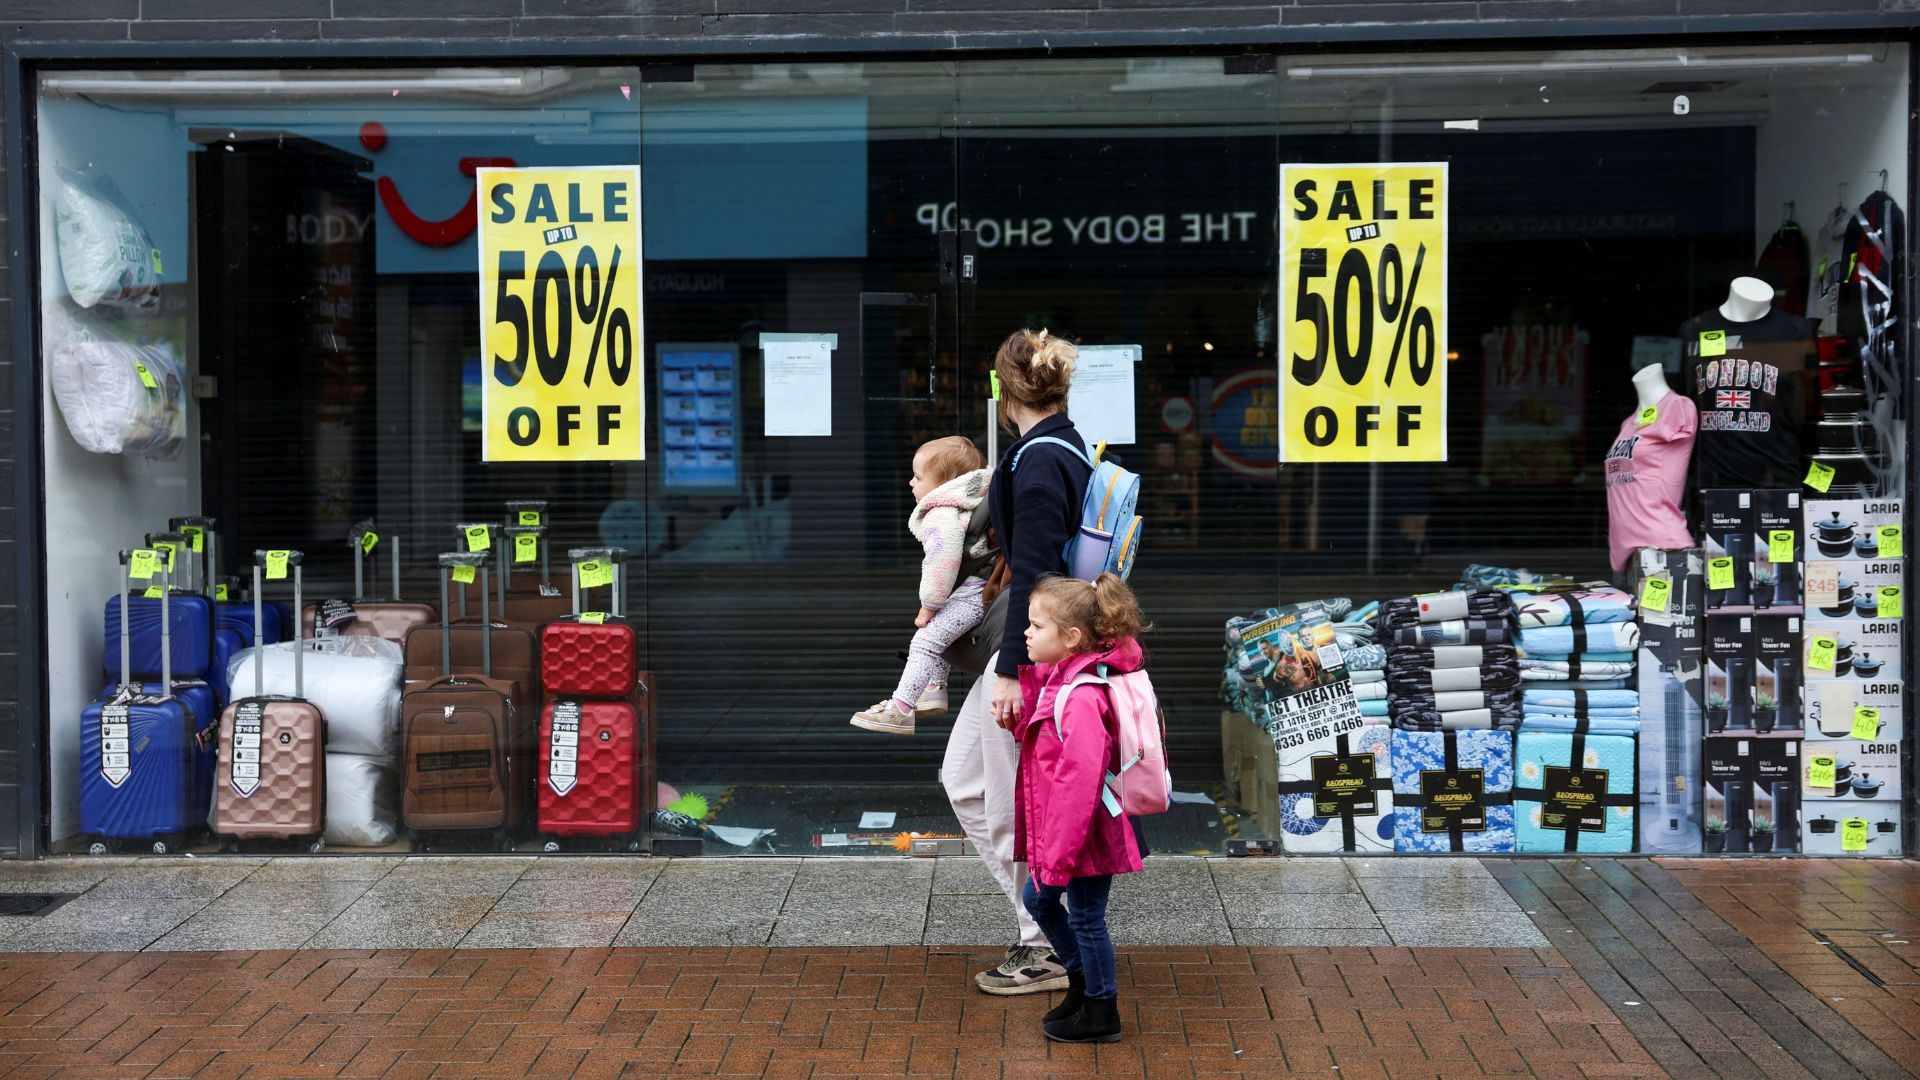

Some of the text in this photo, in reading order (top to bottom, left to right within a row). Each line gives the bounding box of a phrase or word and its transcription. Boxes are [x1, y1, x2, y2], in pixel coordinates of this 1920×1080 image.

[491, 182, 628, 223] SALE
[1293, 179, 1435, 221] SALE
[546, 226, 574, 244] UP TO
[1349, 223, 1377, 242] UP TO
[494, 244, 632, 389] 50%
[1291, 242, 1435, 388] 50%
[1696, 358, 1779, 396] LONDON
[507, 405, 621, 446] OFF
[1304, 405, 1422, 447] OFF
[1701, 410, 1771, 432] ENGLAND
[1863, 503, 1900, 514] LARIA
[1880, 539, 1899, 556] 40
[134, 560, 152, 574] 25
[1865, 563, 1901, 575] LARIA
[1807, 579, 1836, 592] £45
[1671, 602, 1681, 611] 36
[1242, 615, 1297, 641] WRESTLING
[1675, 627, 1696, 638] Fan
[1862, 623, 1899, 634] LARIA
[1863, 684, 1900, 694] LARIA
[1268, 680, 1354, 717] ACT THEATRE
[1271, 700, 1357, 733] SAT 14TH SEPT @ 7PM
[1306, 725, 1330, 742] 666
[1333, 715, 1364, 735] 4466
[1855, 719, 1876, 733] 40
[1861, 744, 1898, 754] LARIA
[1325, 778, 1364, 787] BEDSPREAD
[1433, 793, 1473, 802] BEDSPREAD
[1555, 791, 1595, 801] BEDSPREAD
[1845, 832, 1864, 847] 40
